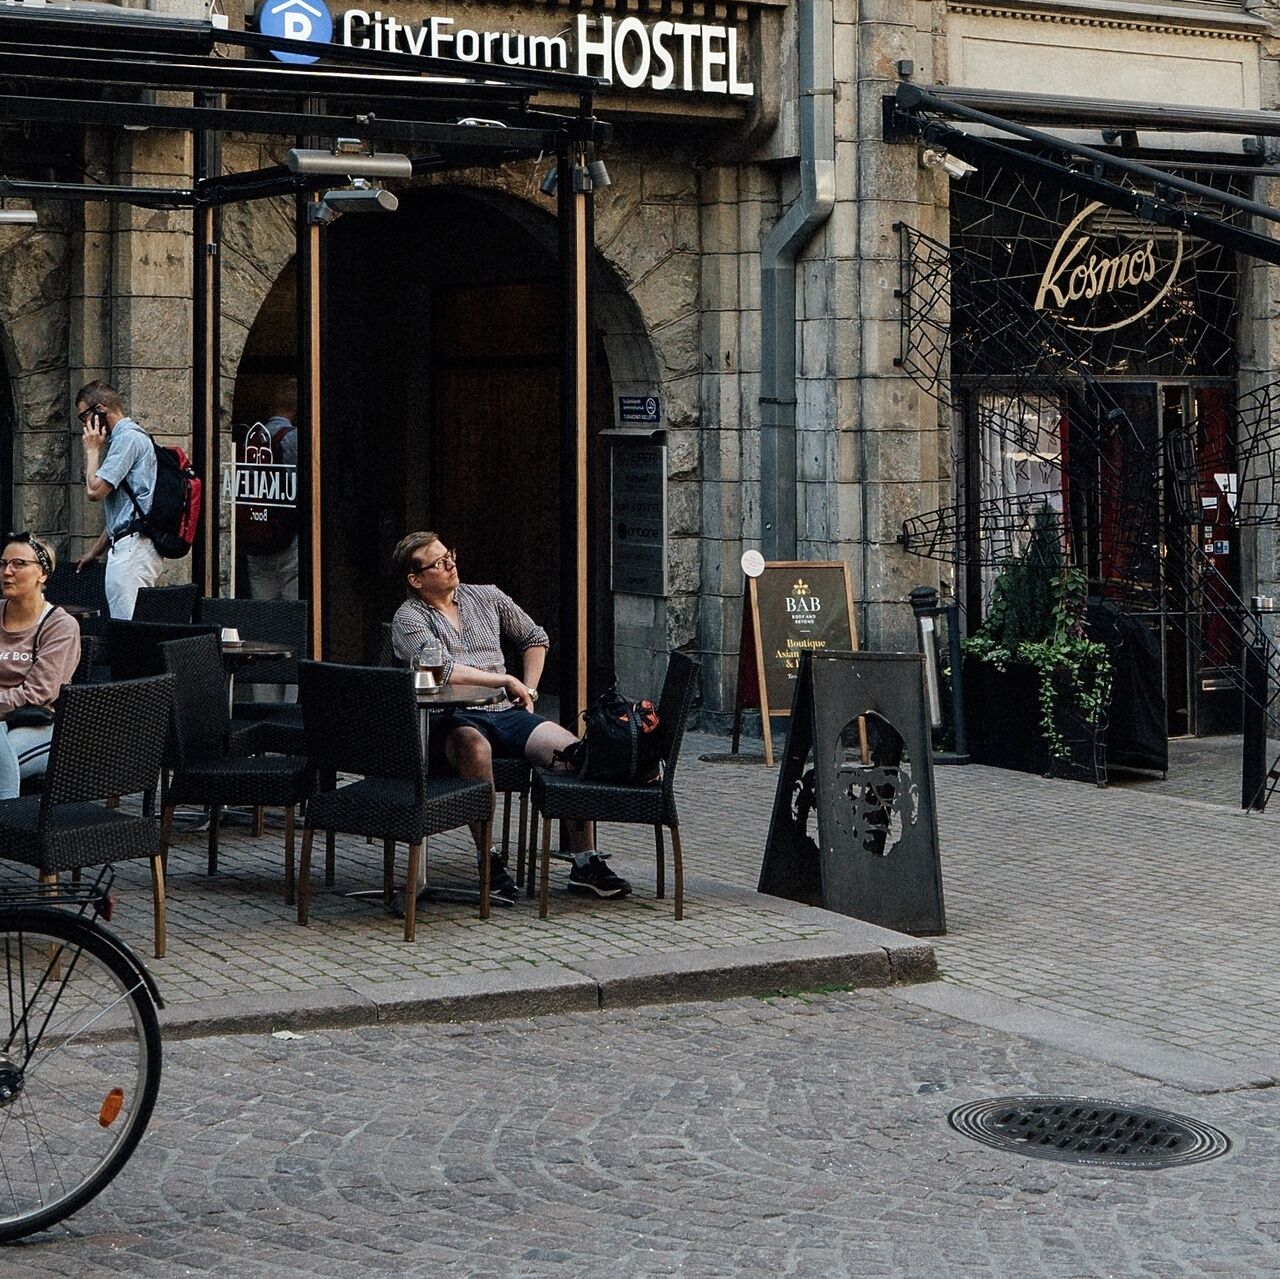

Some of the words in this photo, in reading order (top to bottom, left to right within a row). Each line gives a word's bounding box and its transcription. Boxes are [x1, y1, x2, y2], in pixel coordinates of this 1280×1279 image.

[343, 9, 567, 69] CityForum
[577, 13, 755, 96] HOSTEL
[1034, 208, 1156, 311] Kosmos
[785, 597, 821, 612] BAB
[786, 638, 826, 650] Boutique
[775, 649, 800, 659] Asian
